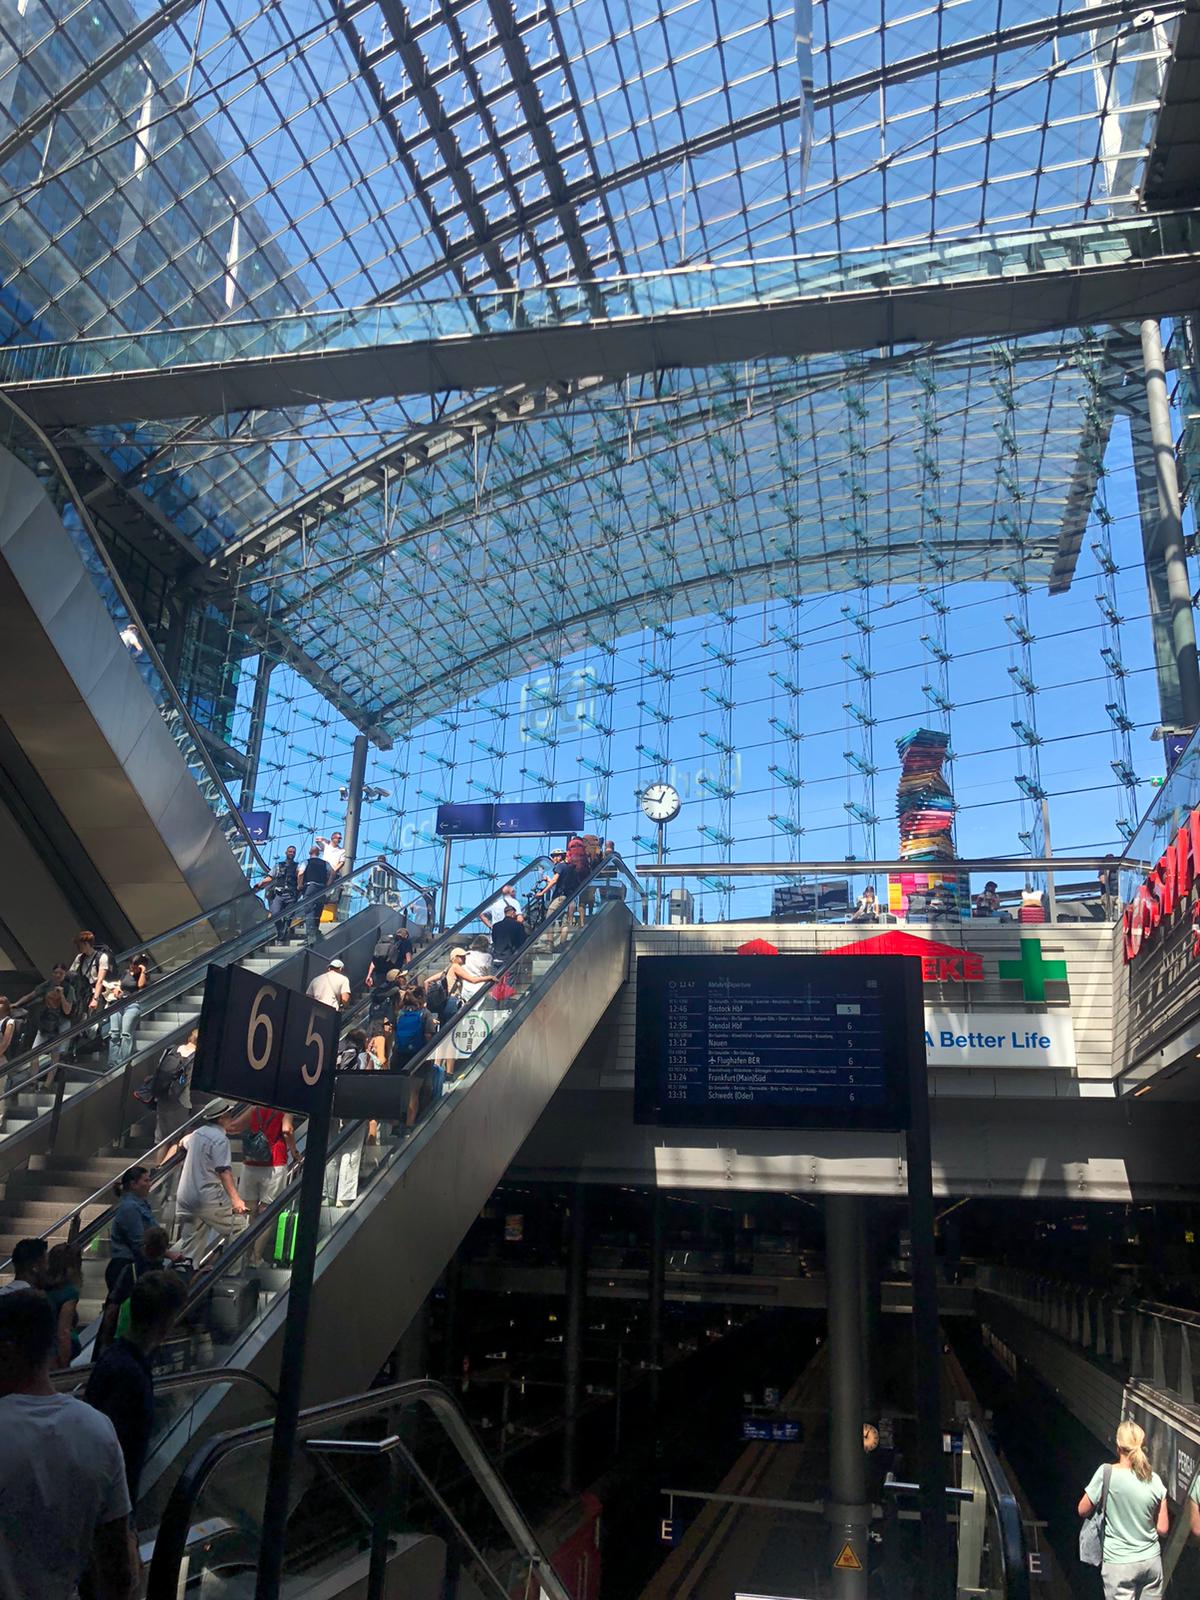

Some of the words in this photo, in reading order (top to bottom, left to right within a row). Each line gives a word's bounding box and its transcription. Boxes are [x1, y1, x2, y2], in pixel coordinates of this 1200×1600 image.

[847, 1022, 853, 1030] 6
[247, 984, 278, 1071] 6
[301, 1007, 330, 1086] 5
[847, 1039, 853, 1048] 5
[940, 1032, 1005, 1048] Better
[1012, 1032, 1051, 1049] Life
[668, 1055, 687, 1063] 13:21
[717, 1056, 747, 1065] Flughafen
[748, 1056, 761, 1064] BER
[848, 1057, 854, 1065] 6
[668, 1073, 687, 1081] 13:24
[849, 1075, 854, 1083] 5
[849, 1093, 855, 1101] 6
[661, 1519, 673, 1540] E
[1029, 1552, 1042, 1573] E
